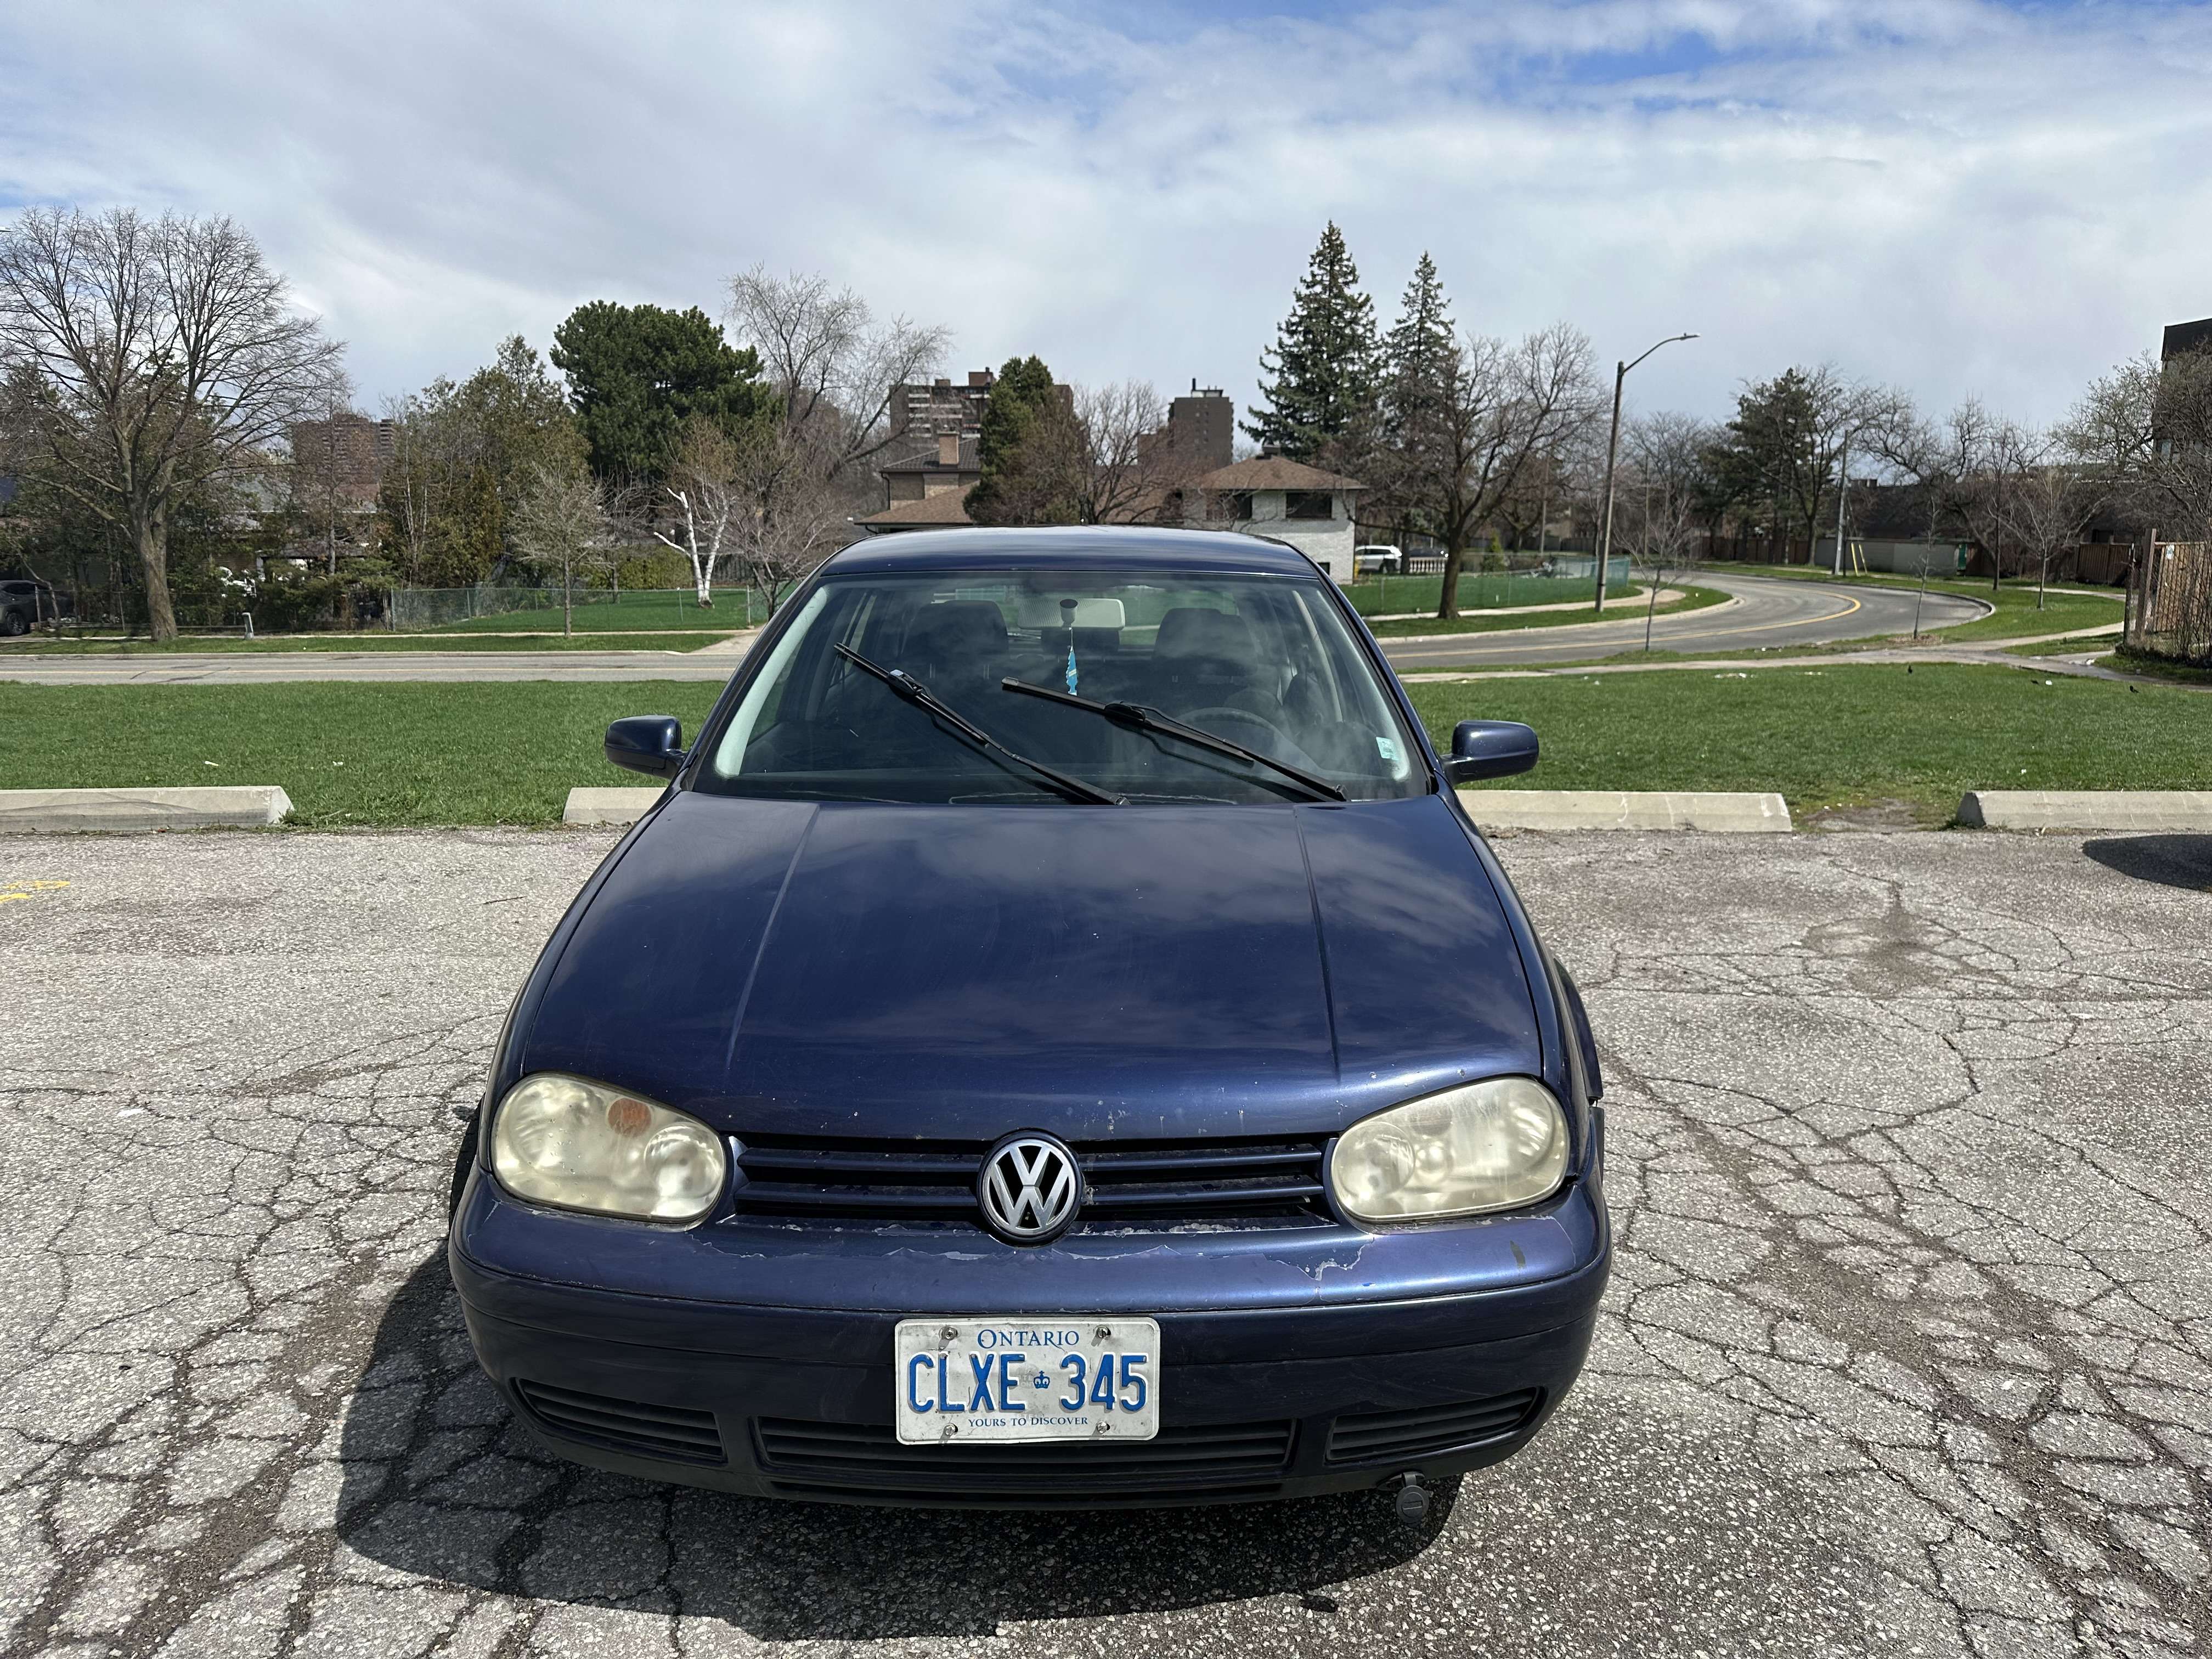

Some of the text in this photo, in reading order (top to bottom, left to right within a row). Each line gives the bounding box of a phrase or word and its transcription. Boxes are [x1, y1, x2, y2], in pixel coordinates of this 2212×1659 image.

[986, 1140, 1074, 1234] VW
[977, 1329, 1080, 1349] ONTARIO
[908, 1353, 1147, 1412] CLXE 345
[968, 1416, 1089, 1428] YOURS TO DISCOVER
